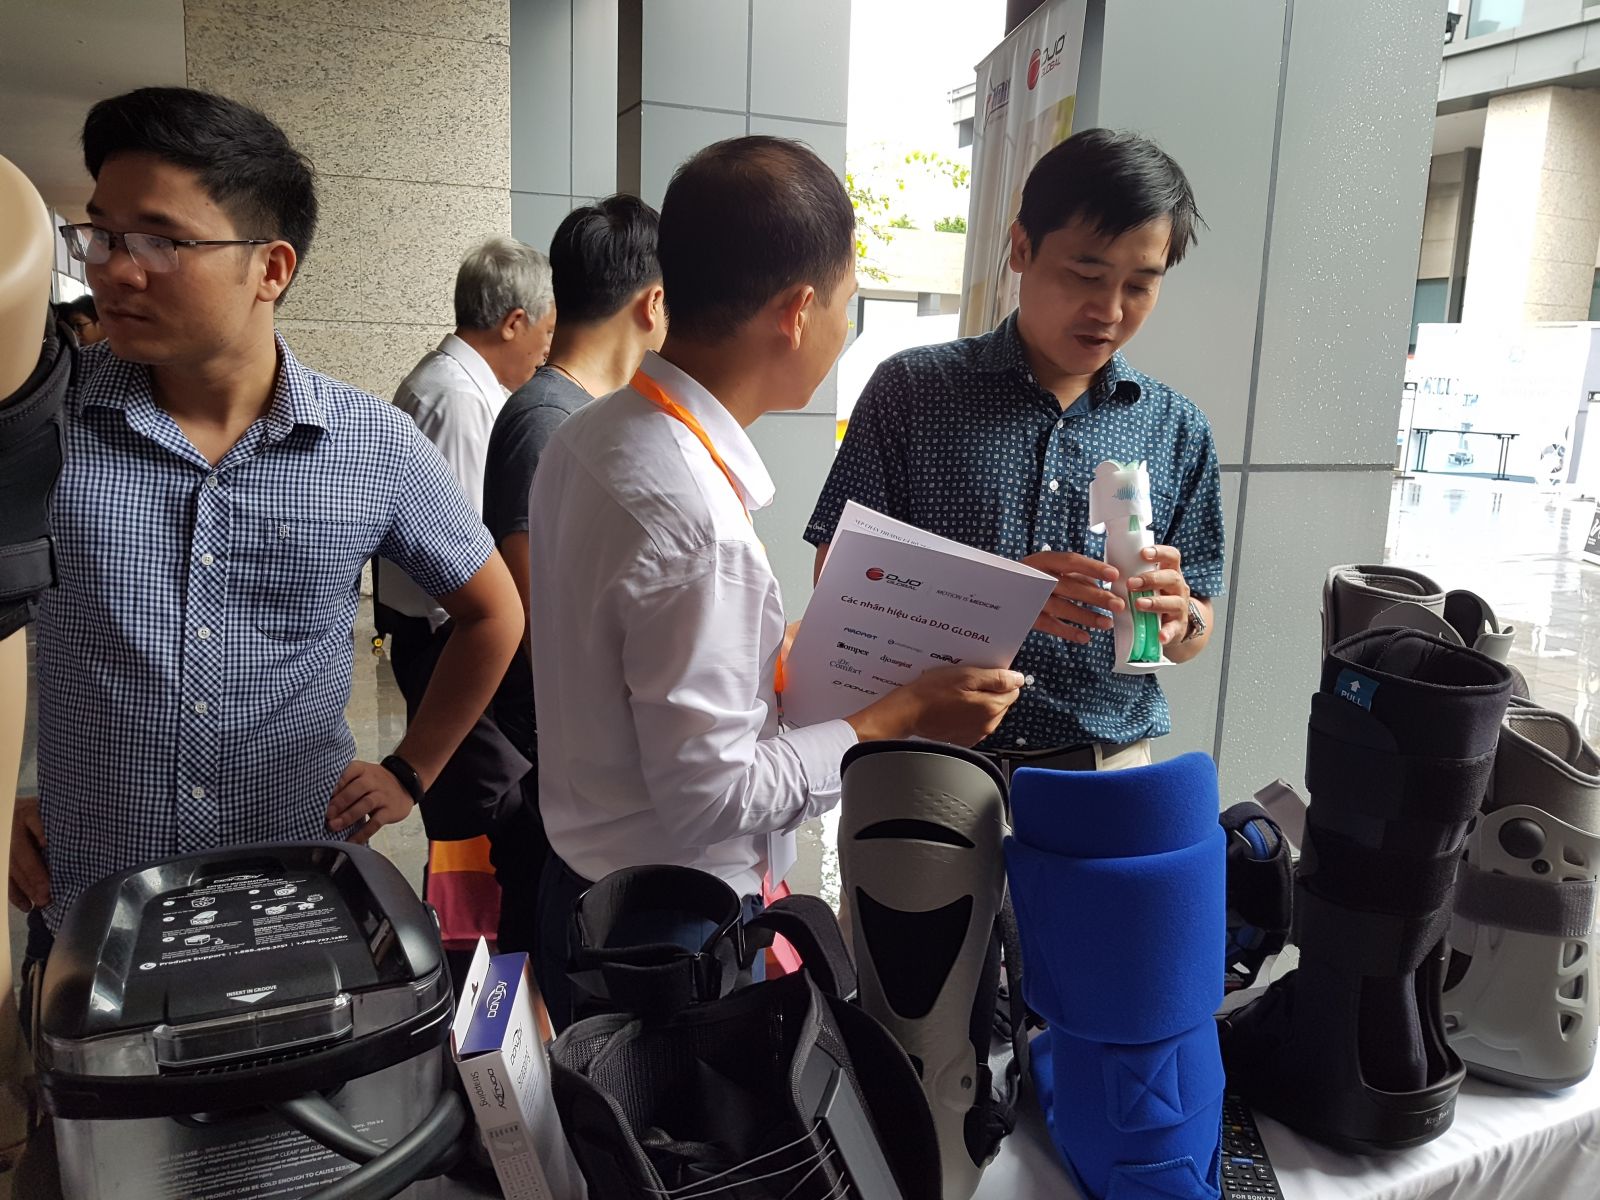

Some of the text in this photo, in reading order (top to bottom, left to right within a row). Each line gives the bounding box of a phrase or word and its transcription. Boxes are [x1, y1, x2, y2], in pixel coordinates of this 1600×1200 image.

[885, 573, 922, 587] DJO
[969, 598, 1001, 610] MEDICINE
[841, 595, 858, 605] Các
[887, 606, 908, 619] hiệu
[910, 614, 928, 625] của
[929, 619, 950, 631] DJO
[951, 626, 990, 644] GLOBAL
[829, 660, 862, 675] Comfort
[1340, 689, 1363, 706] PULL
[159, 957, 192, 966] Product
[193, 952, 226, 961] Support
[226, 989, 246, 997] INSERT
[253, 984, 278, 993] GROOVE
[486, 980, 508, 1019] DONJOY
[487, 1068, 507, 1109] DONJOY
[205, 1189, 236, 1200] PRODUCT
[236, 1186, 251, 1194] CAN
[251, 1183, 260, 1191] BE
[260, 1180, 278, 1188] COLD
[278, 1174, 305, 1185] ENOUGH
[315, 1167, 335, 1177] CAUSE
